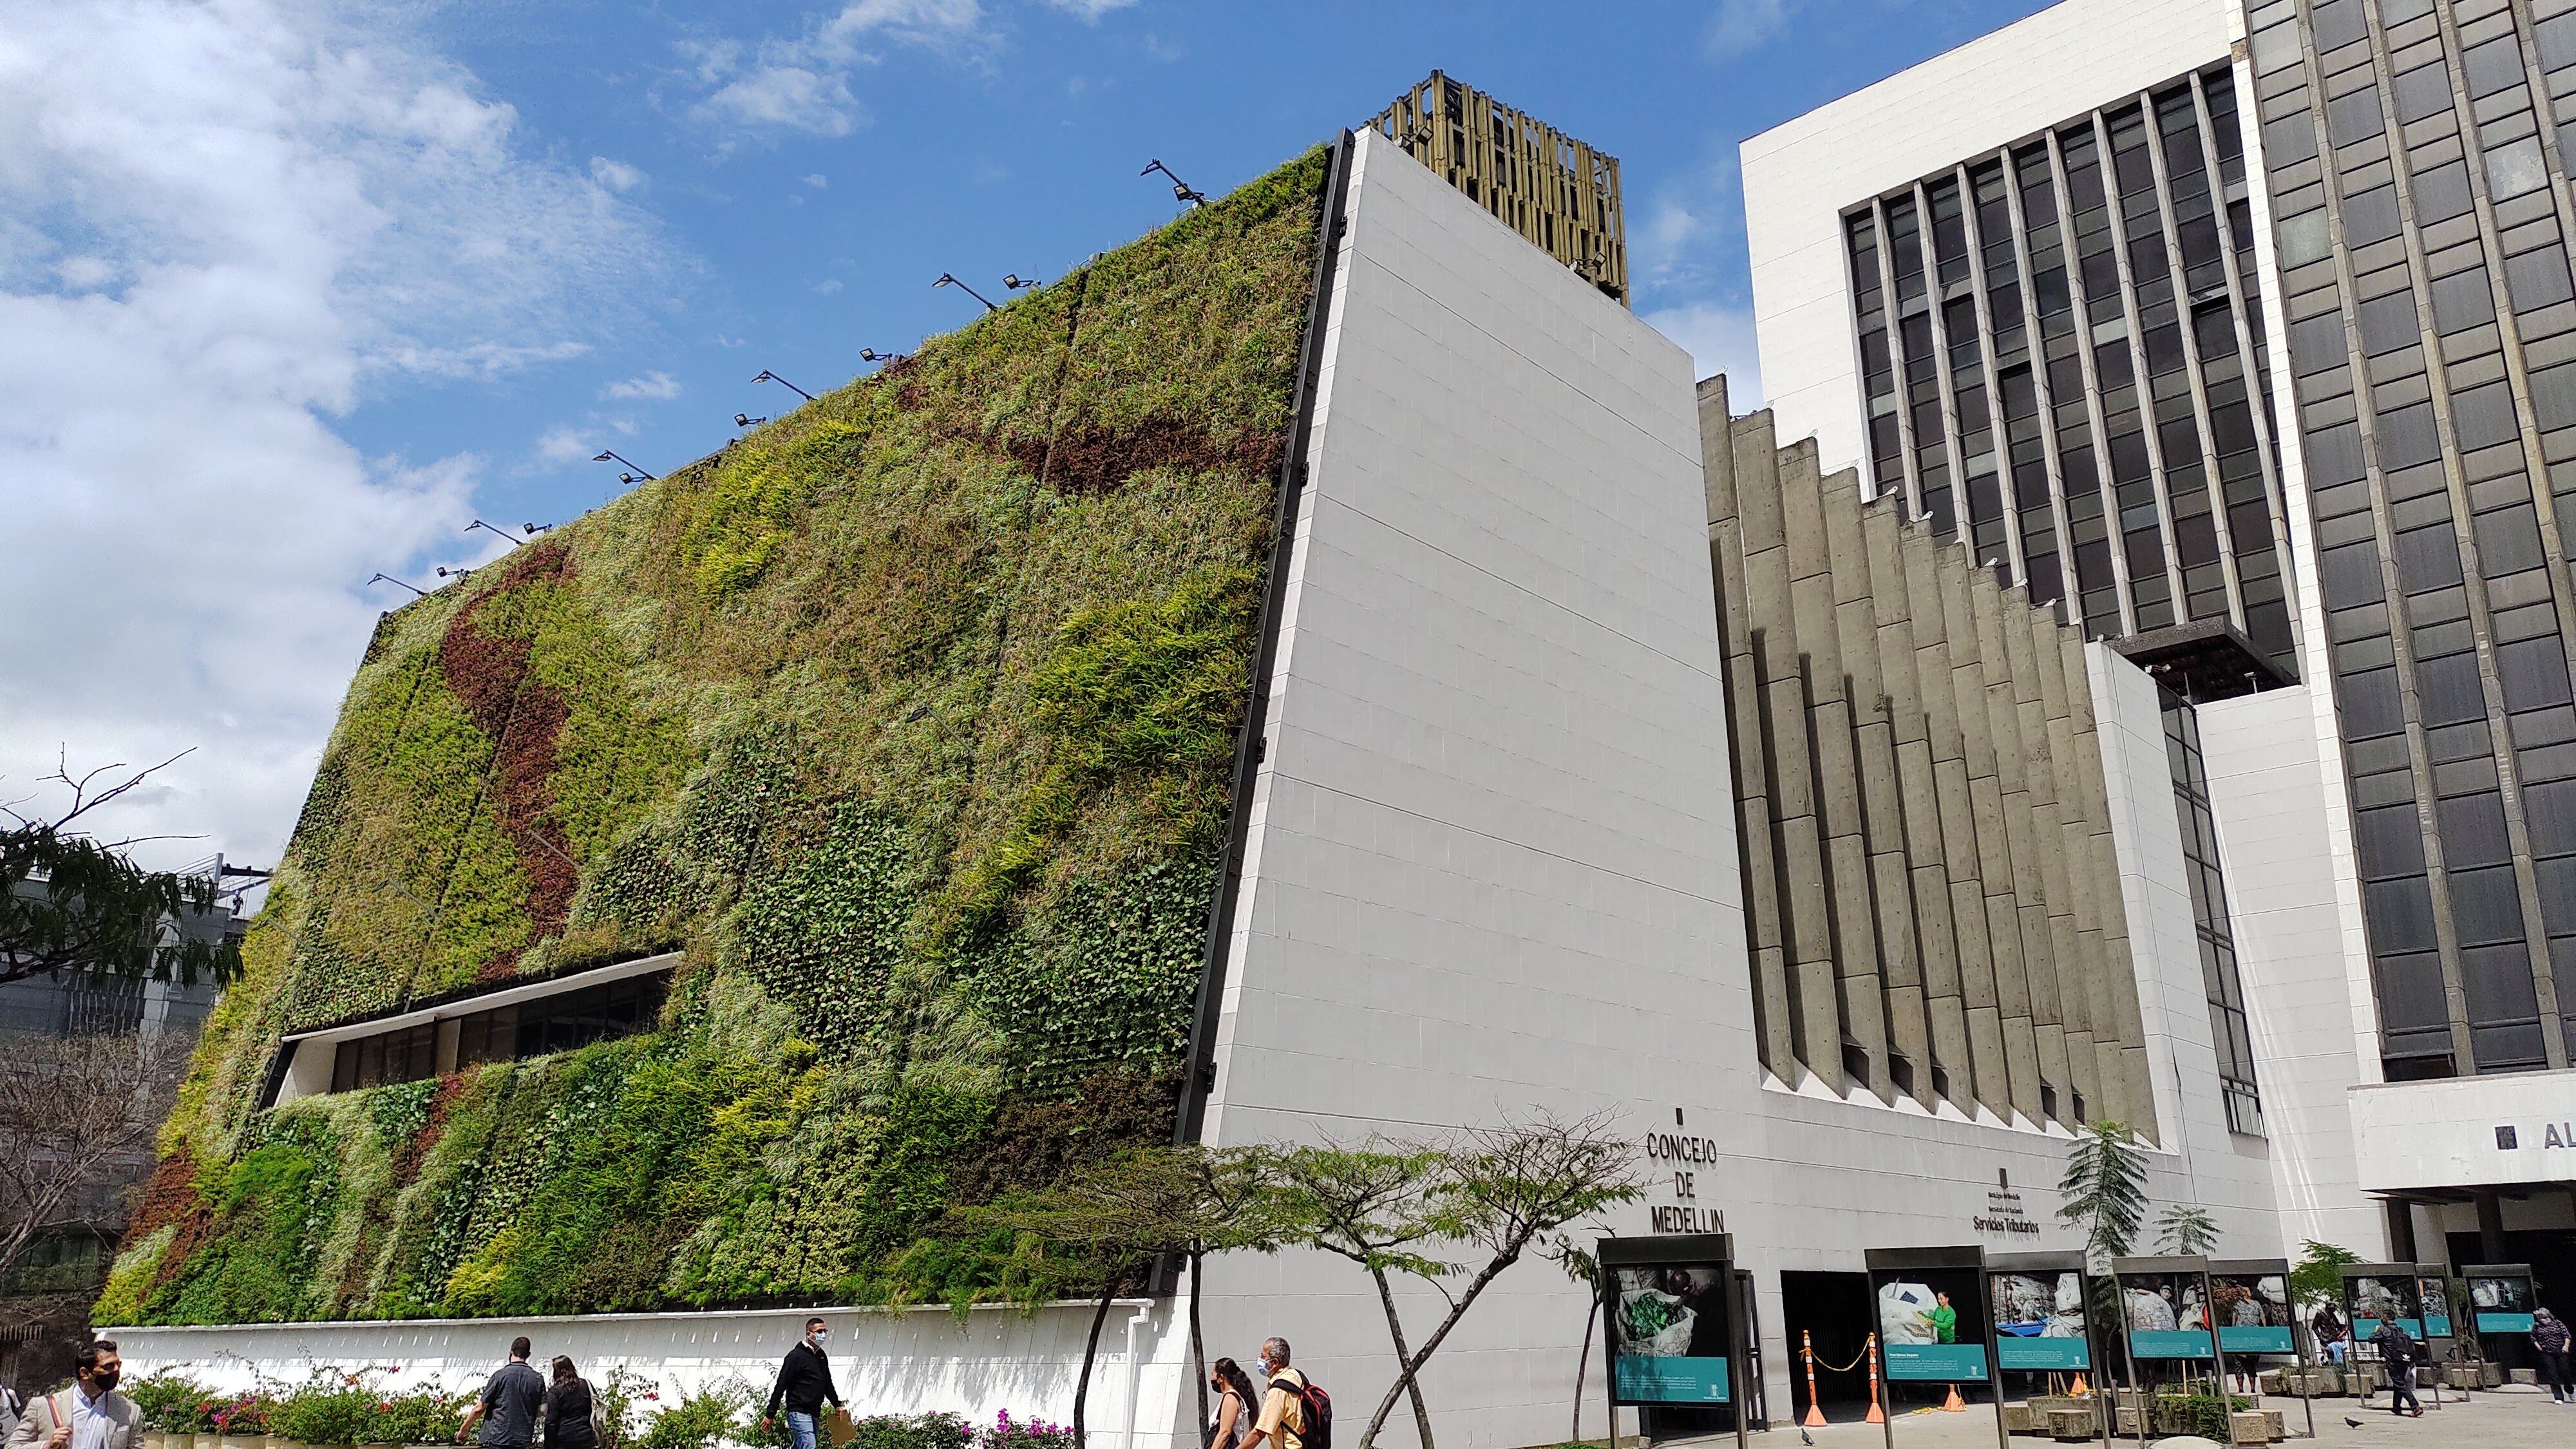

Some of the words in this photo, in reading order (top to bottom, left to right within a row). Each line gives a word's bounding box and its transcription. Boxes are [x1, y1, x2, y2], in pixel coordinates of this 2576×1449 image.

[1647, 1132, 1717, 1164] CONCEJO
[2544, 1122, 2576, 1149] AL
[1675, 1171, 1696, 1198] DE
[1651, 1206, 1725, 1233] MEDELLIN
[1973, 1215, 2005, 1233] Servicios
[2004, 1218, 2040, 1234] Tributarios
